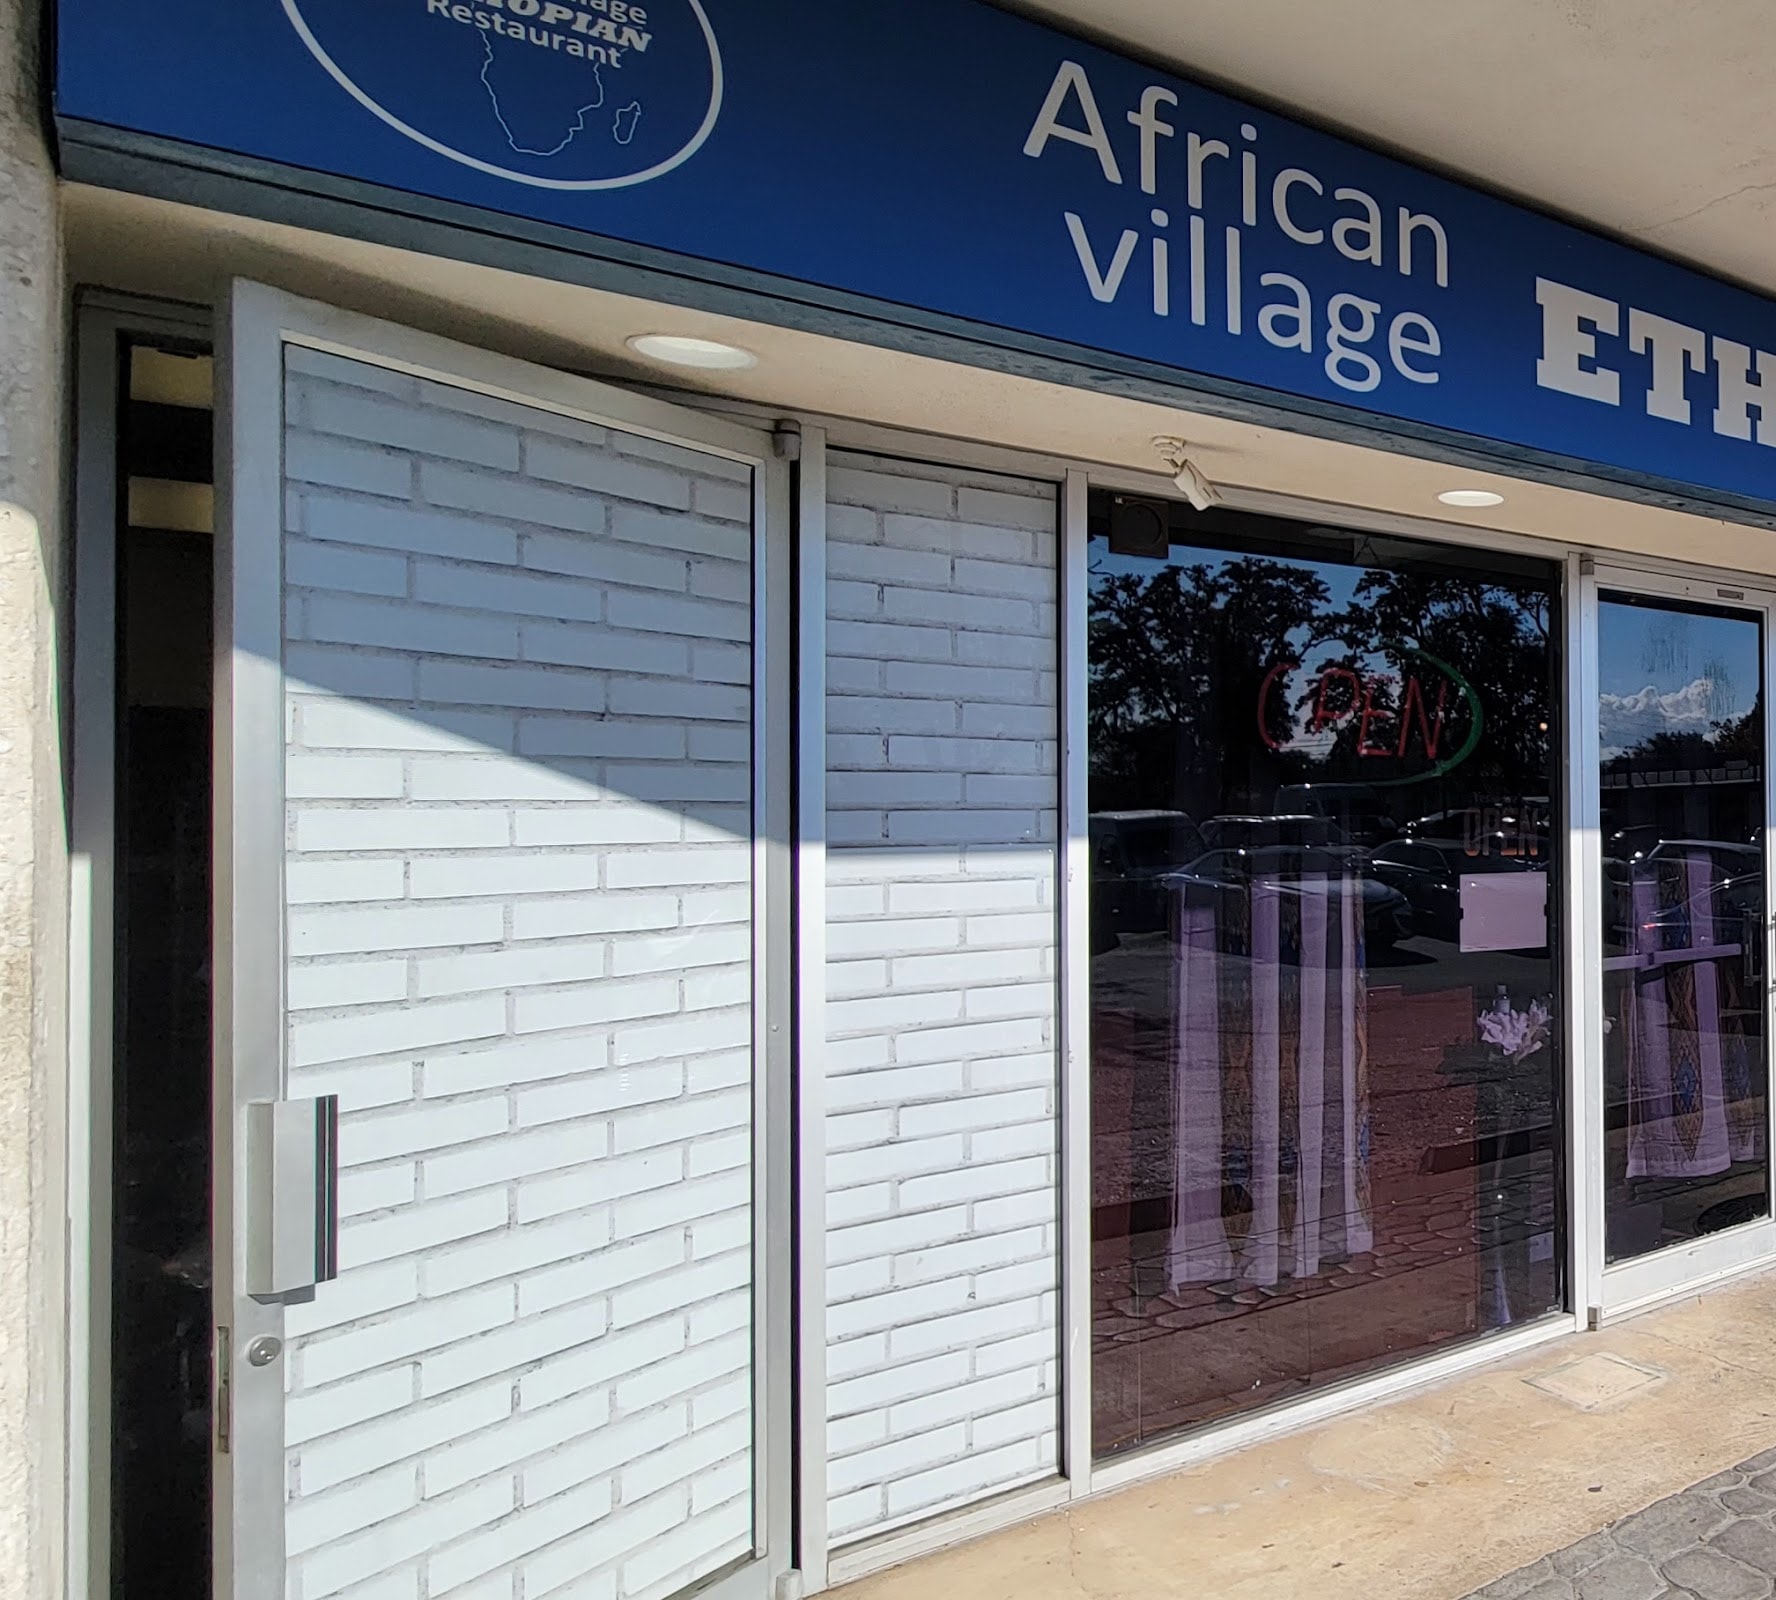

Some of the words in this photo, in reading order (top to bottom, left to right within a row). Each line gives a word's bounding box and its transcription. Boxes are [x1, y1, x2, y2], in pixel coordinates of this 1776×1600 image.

[427, 0, 622, 68] Restaurant
[571, 0, 647, 25] age
[1023, 60, 1448, 288] African
[1064, 208, 1442, 392] village
[1464, 807, 1538, 857] OPEN
